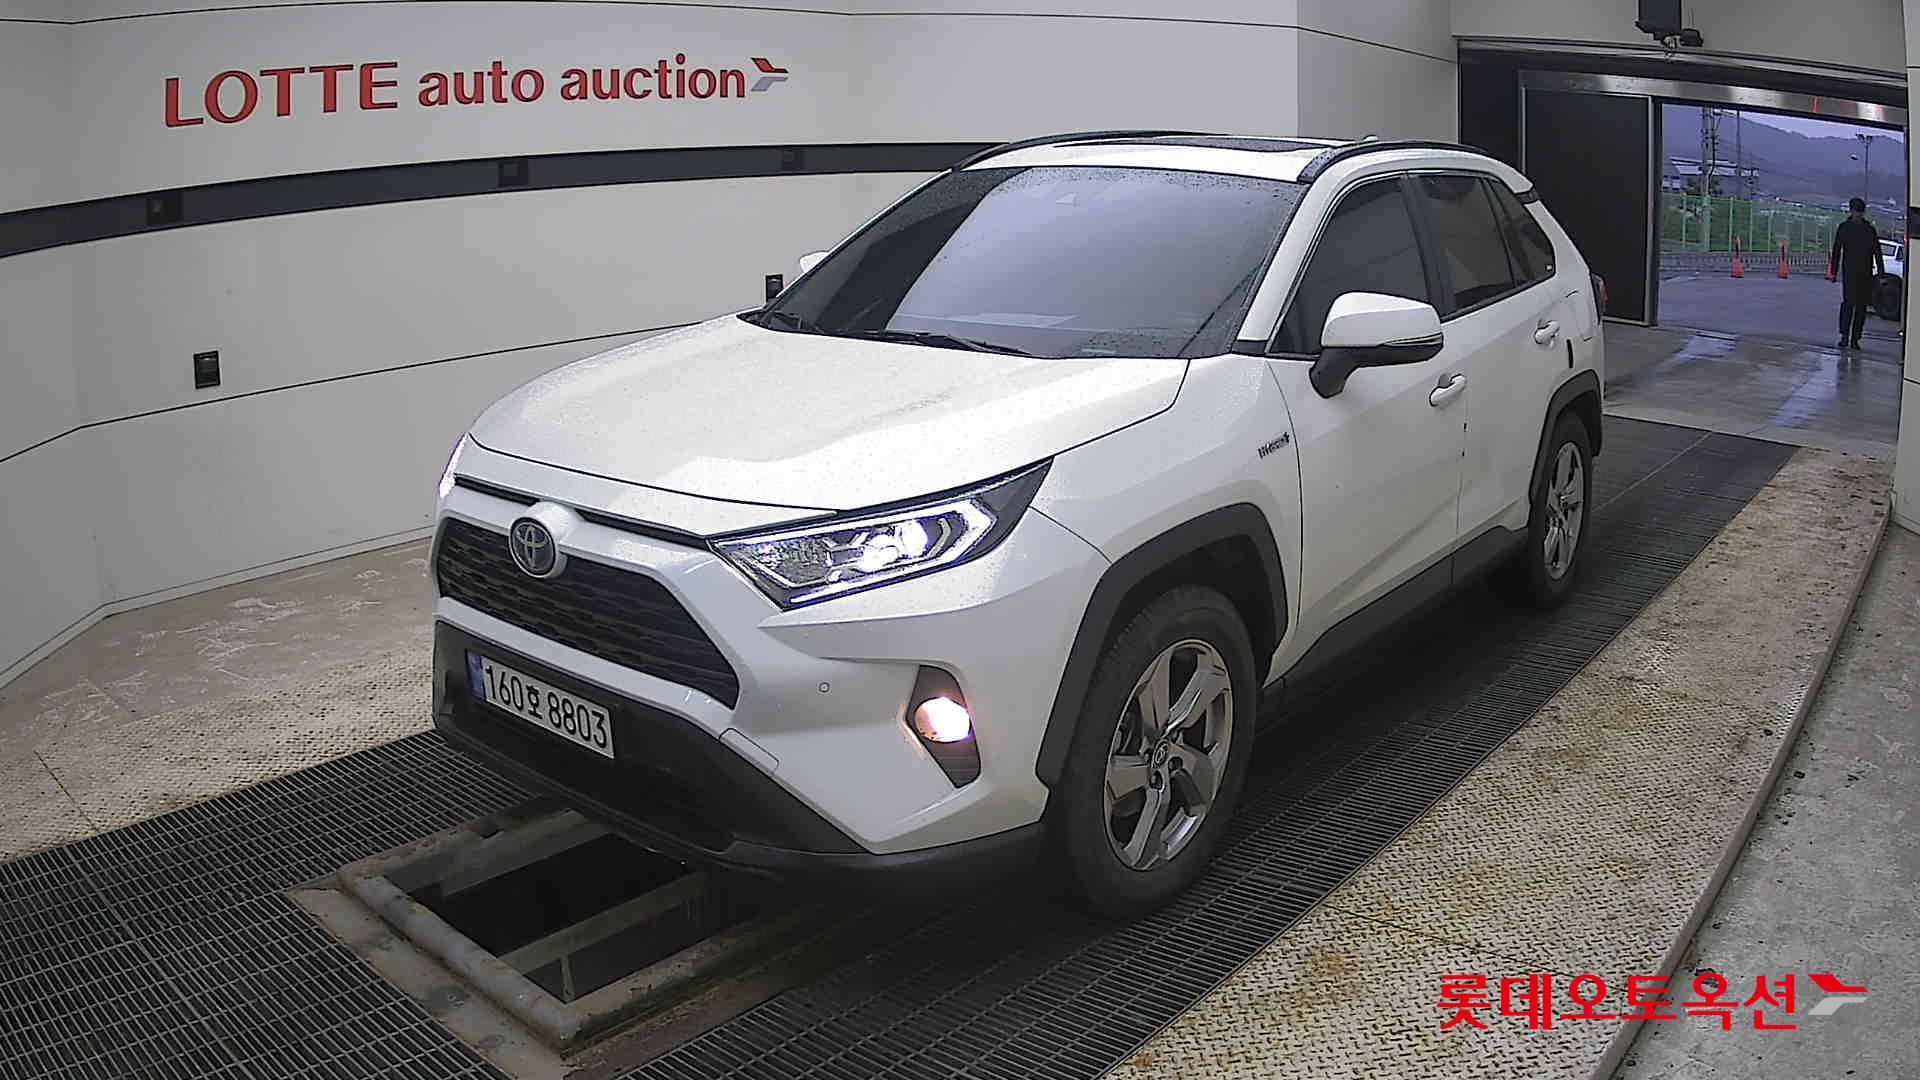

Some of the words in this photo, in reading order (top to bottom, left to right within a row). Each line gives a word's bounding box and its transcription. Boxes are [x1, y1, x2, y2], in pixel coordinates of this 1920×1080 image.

[165, 61, 399, 128] LOTTE
[418, 60, 546, 107] auto
[561, 53, 747, 101] auction
[547, 691, 608, 749] 8803
